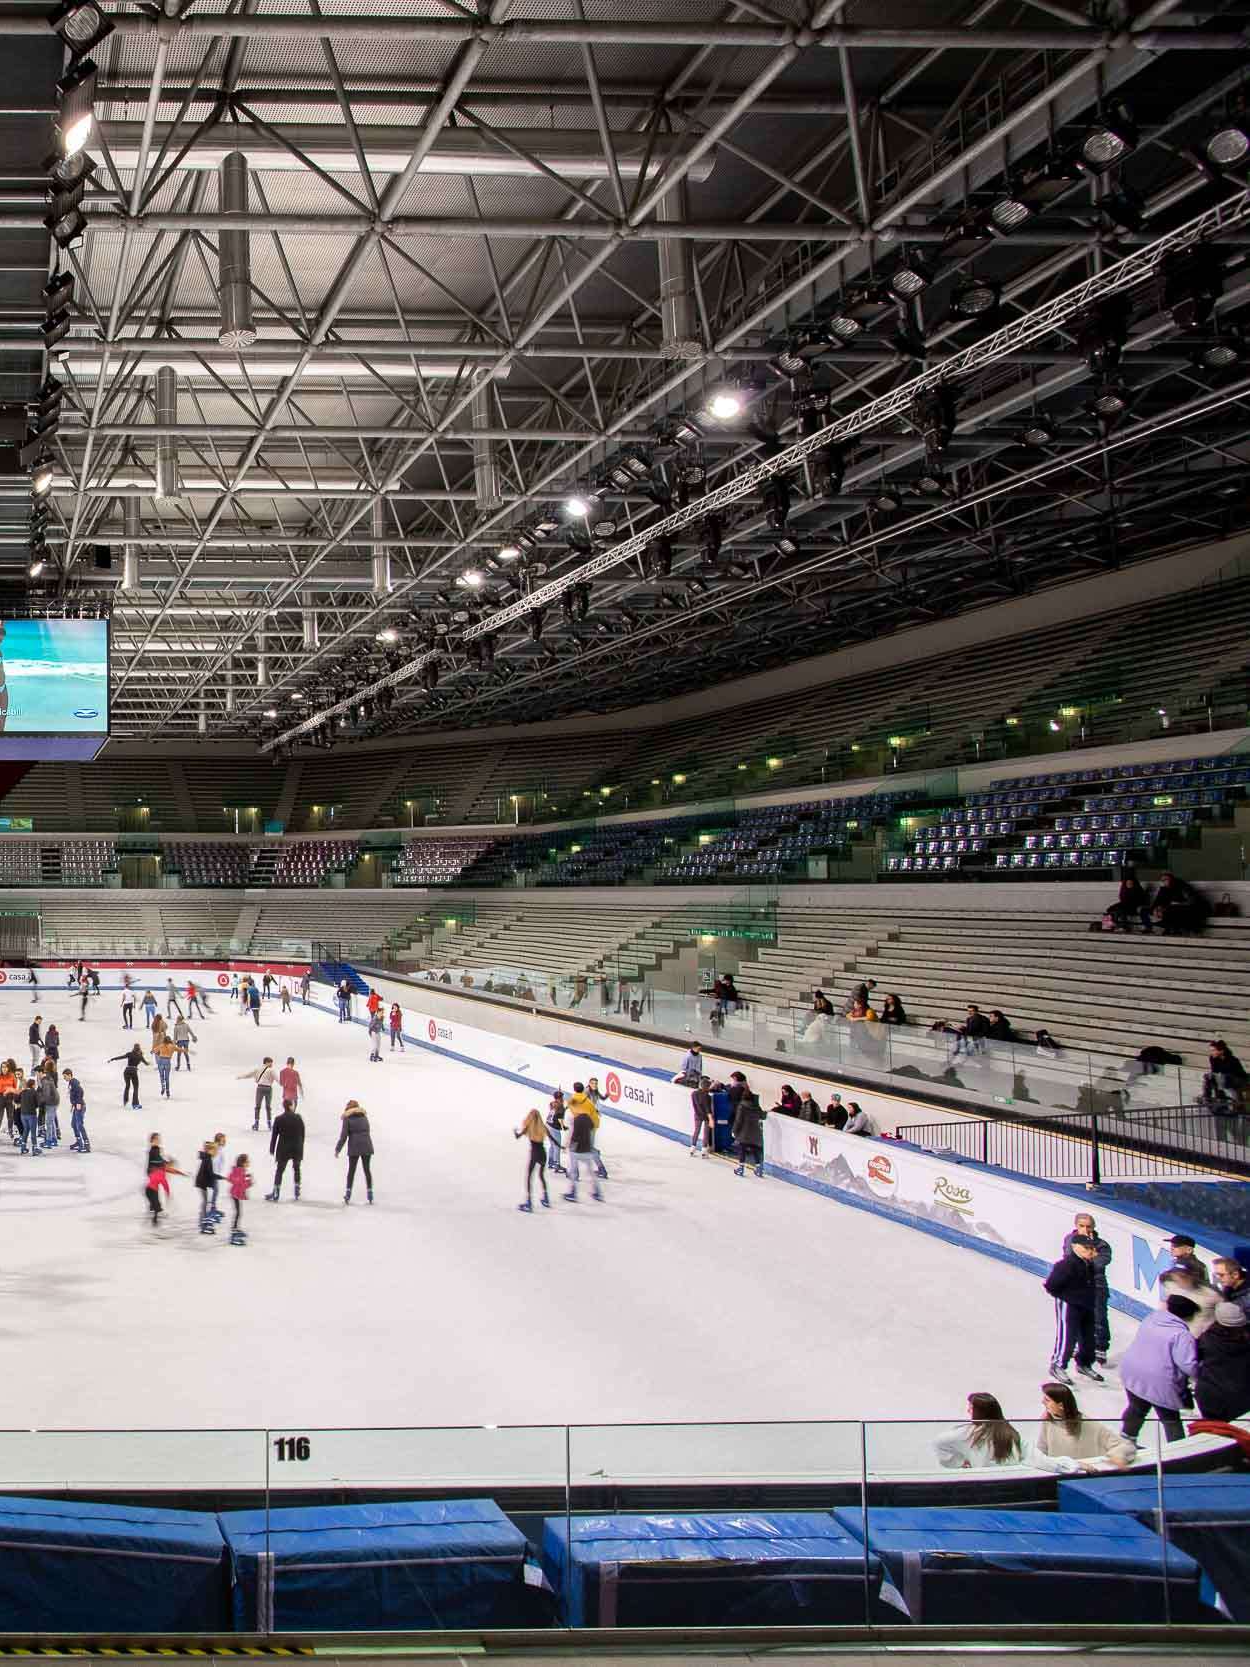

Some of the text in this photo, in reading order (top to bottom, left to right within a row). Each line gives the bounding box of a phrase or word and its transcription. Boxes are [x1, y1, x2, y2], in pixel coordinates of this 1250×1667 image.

[624, 1084, 654, 1107] casa.it
[933, 1176, 974, 1204] Rosa
[273, 1436, 310, 1461] 116
